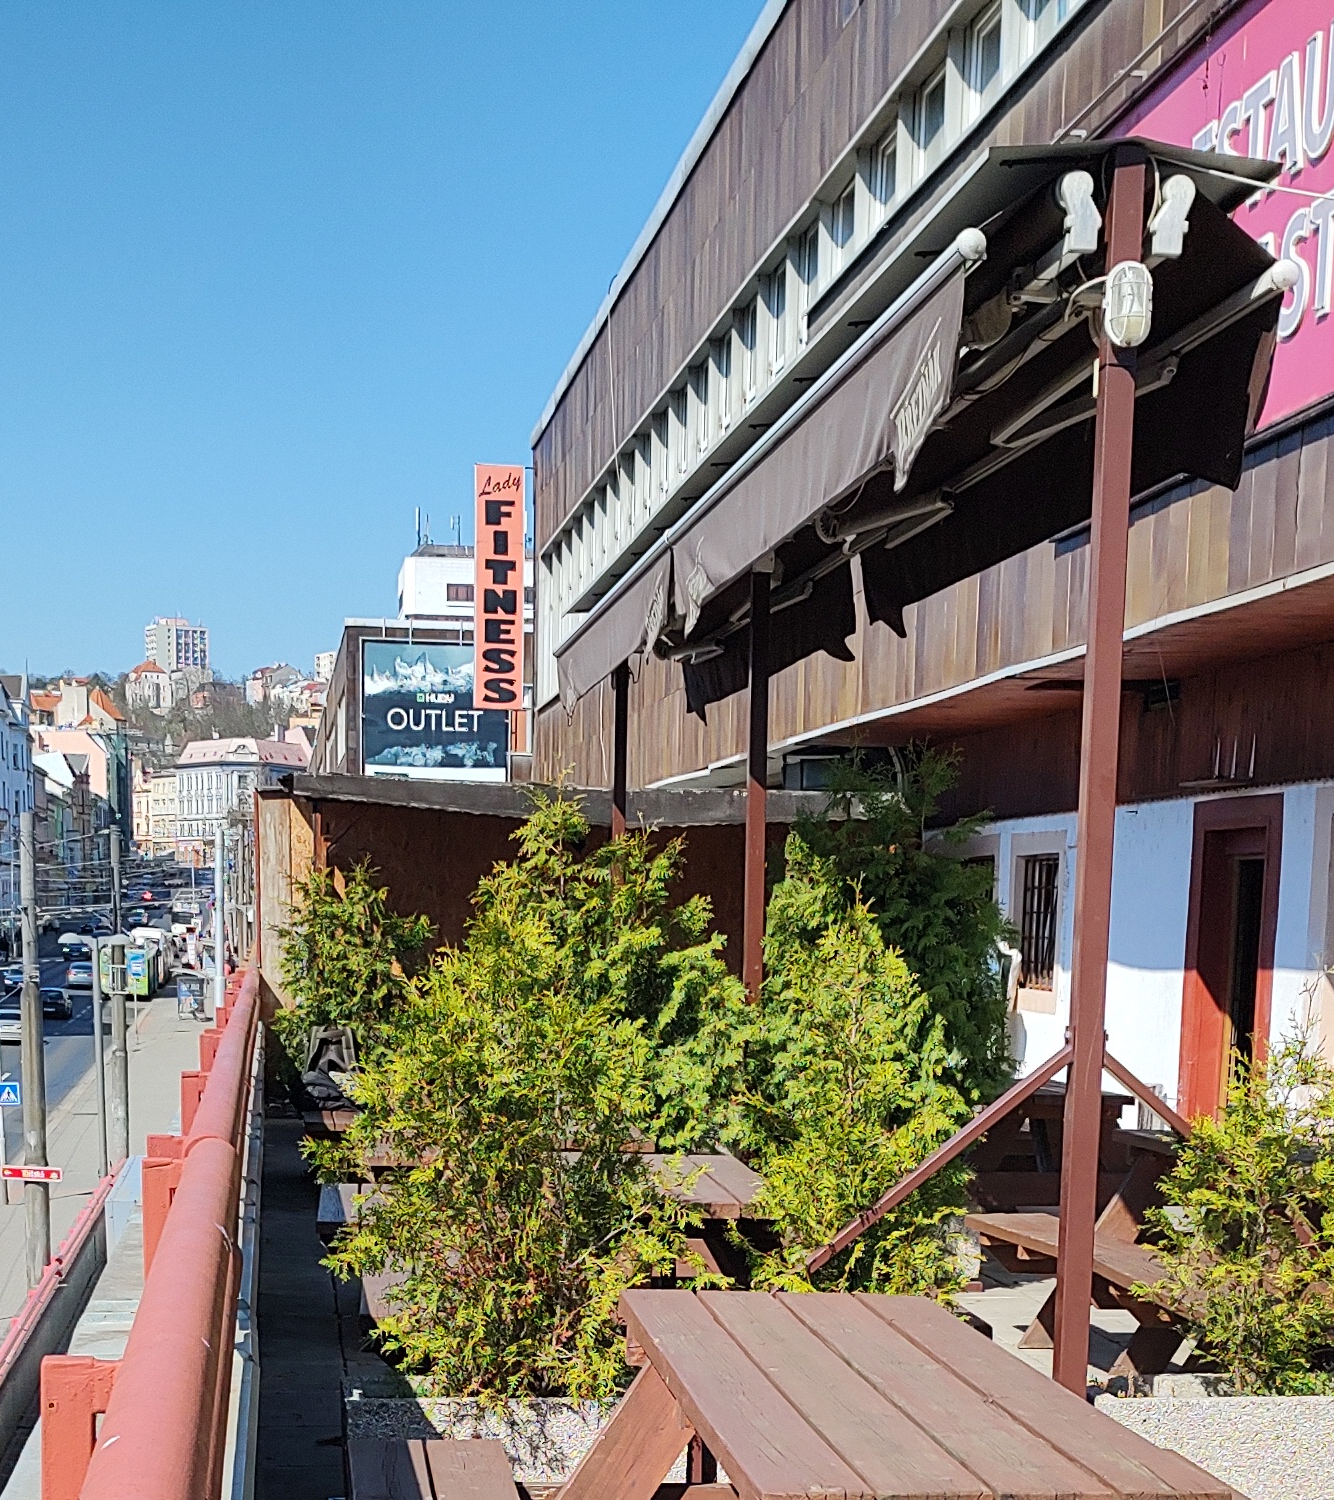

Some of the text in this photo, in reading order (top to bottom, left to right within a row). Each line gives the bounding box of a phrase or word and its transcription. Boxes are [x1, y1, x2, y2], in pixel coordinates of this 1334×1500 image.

[479, 472, 522, 498] Lady
[483, 500, 517, 704] FITNESS
[386, 707, 484, 732] OUTLET
